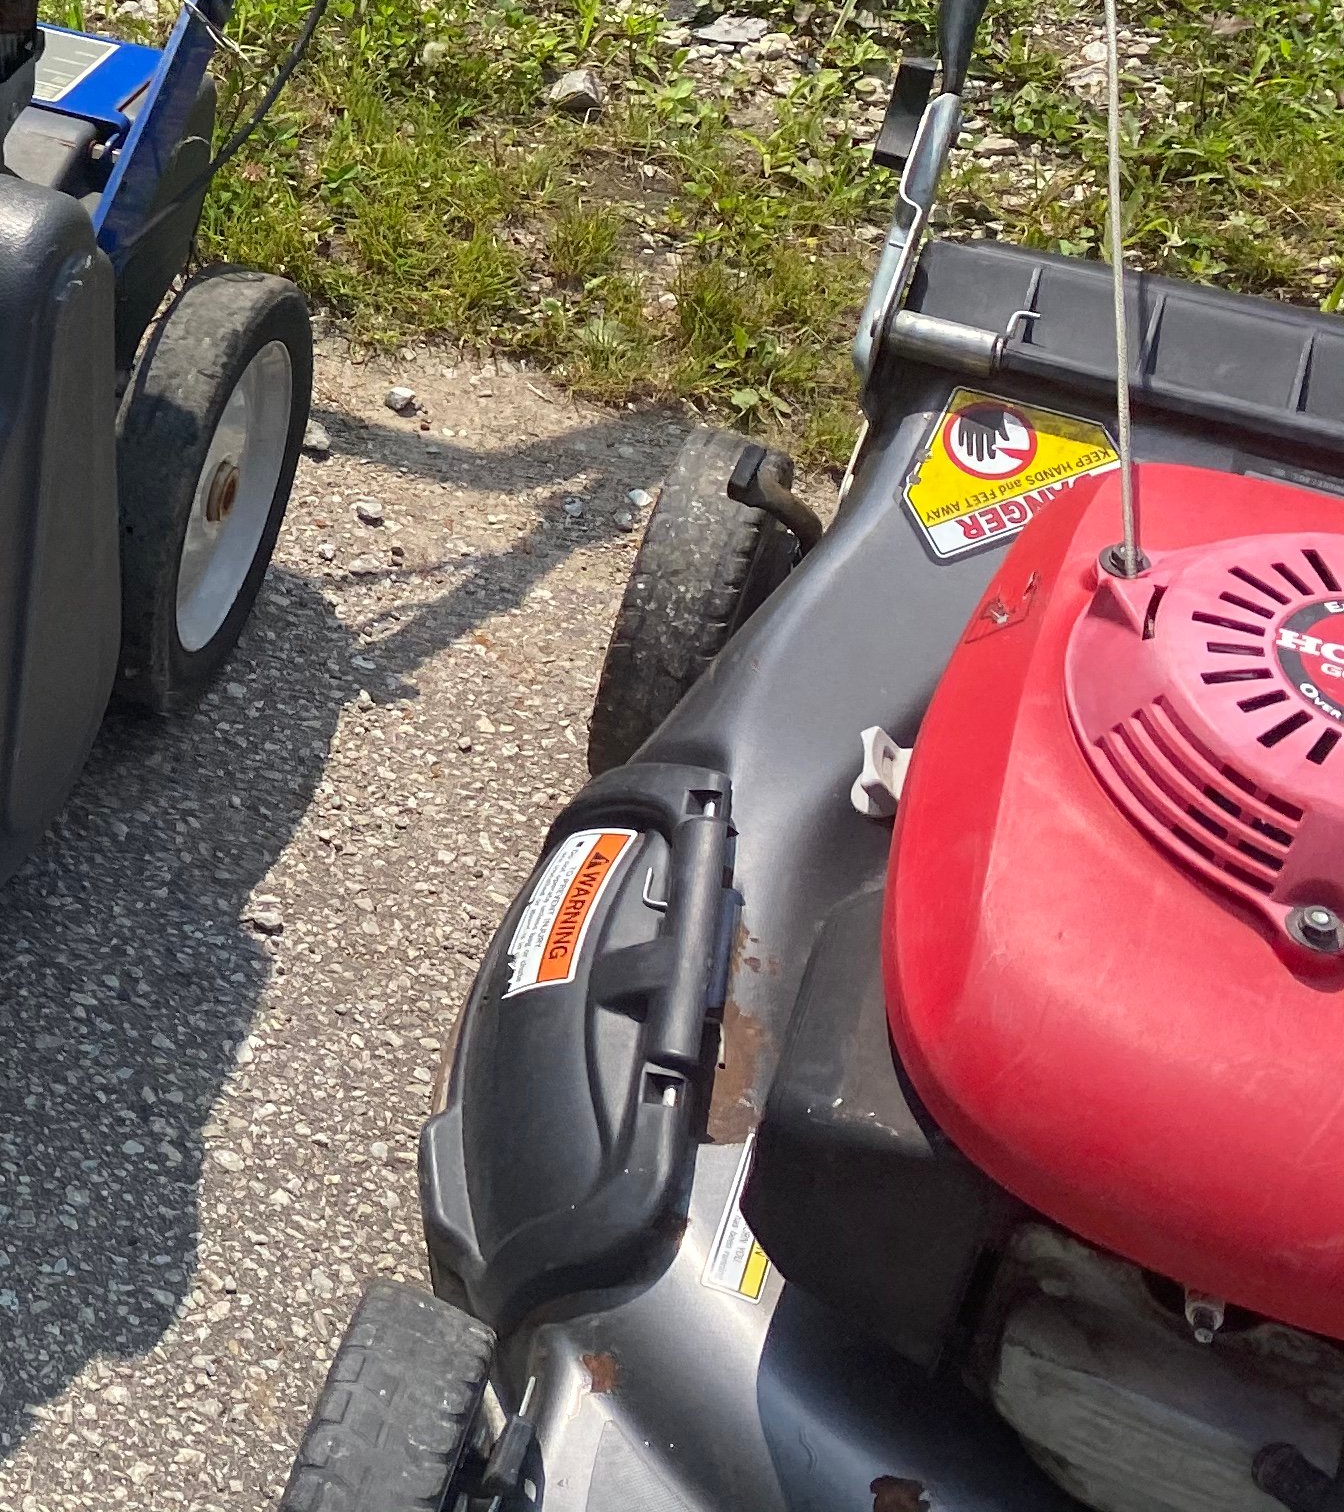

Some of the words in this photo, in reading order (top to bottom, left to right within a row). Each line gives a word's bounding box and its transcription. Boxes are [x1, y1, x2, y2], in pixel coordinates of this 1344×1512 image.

[1024, 456, 1072, 487] HANDS
[1075, 447, 1112, 470] KEEP
[963, 487, 996, 509] FEET
[997, 478, 1023, 497] and
[924, 497, 961, 523] AWAY
[549, 871, 600, 960] WARNING
[536, 918, 550, 948] INJURY
